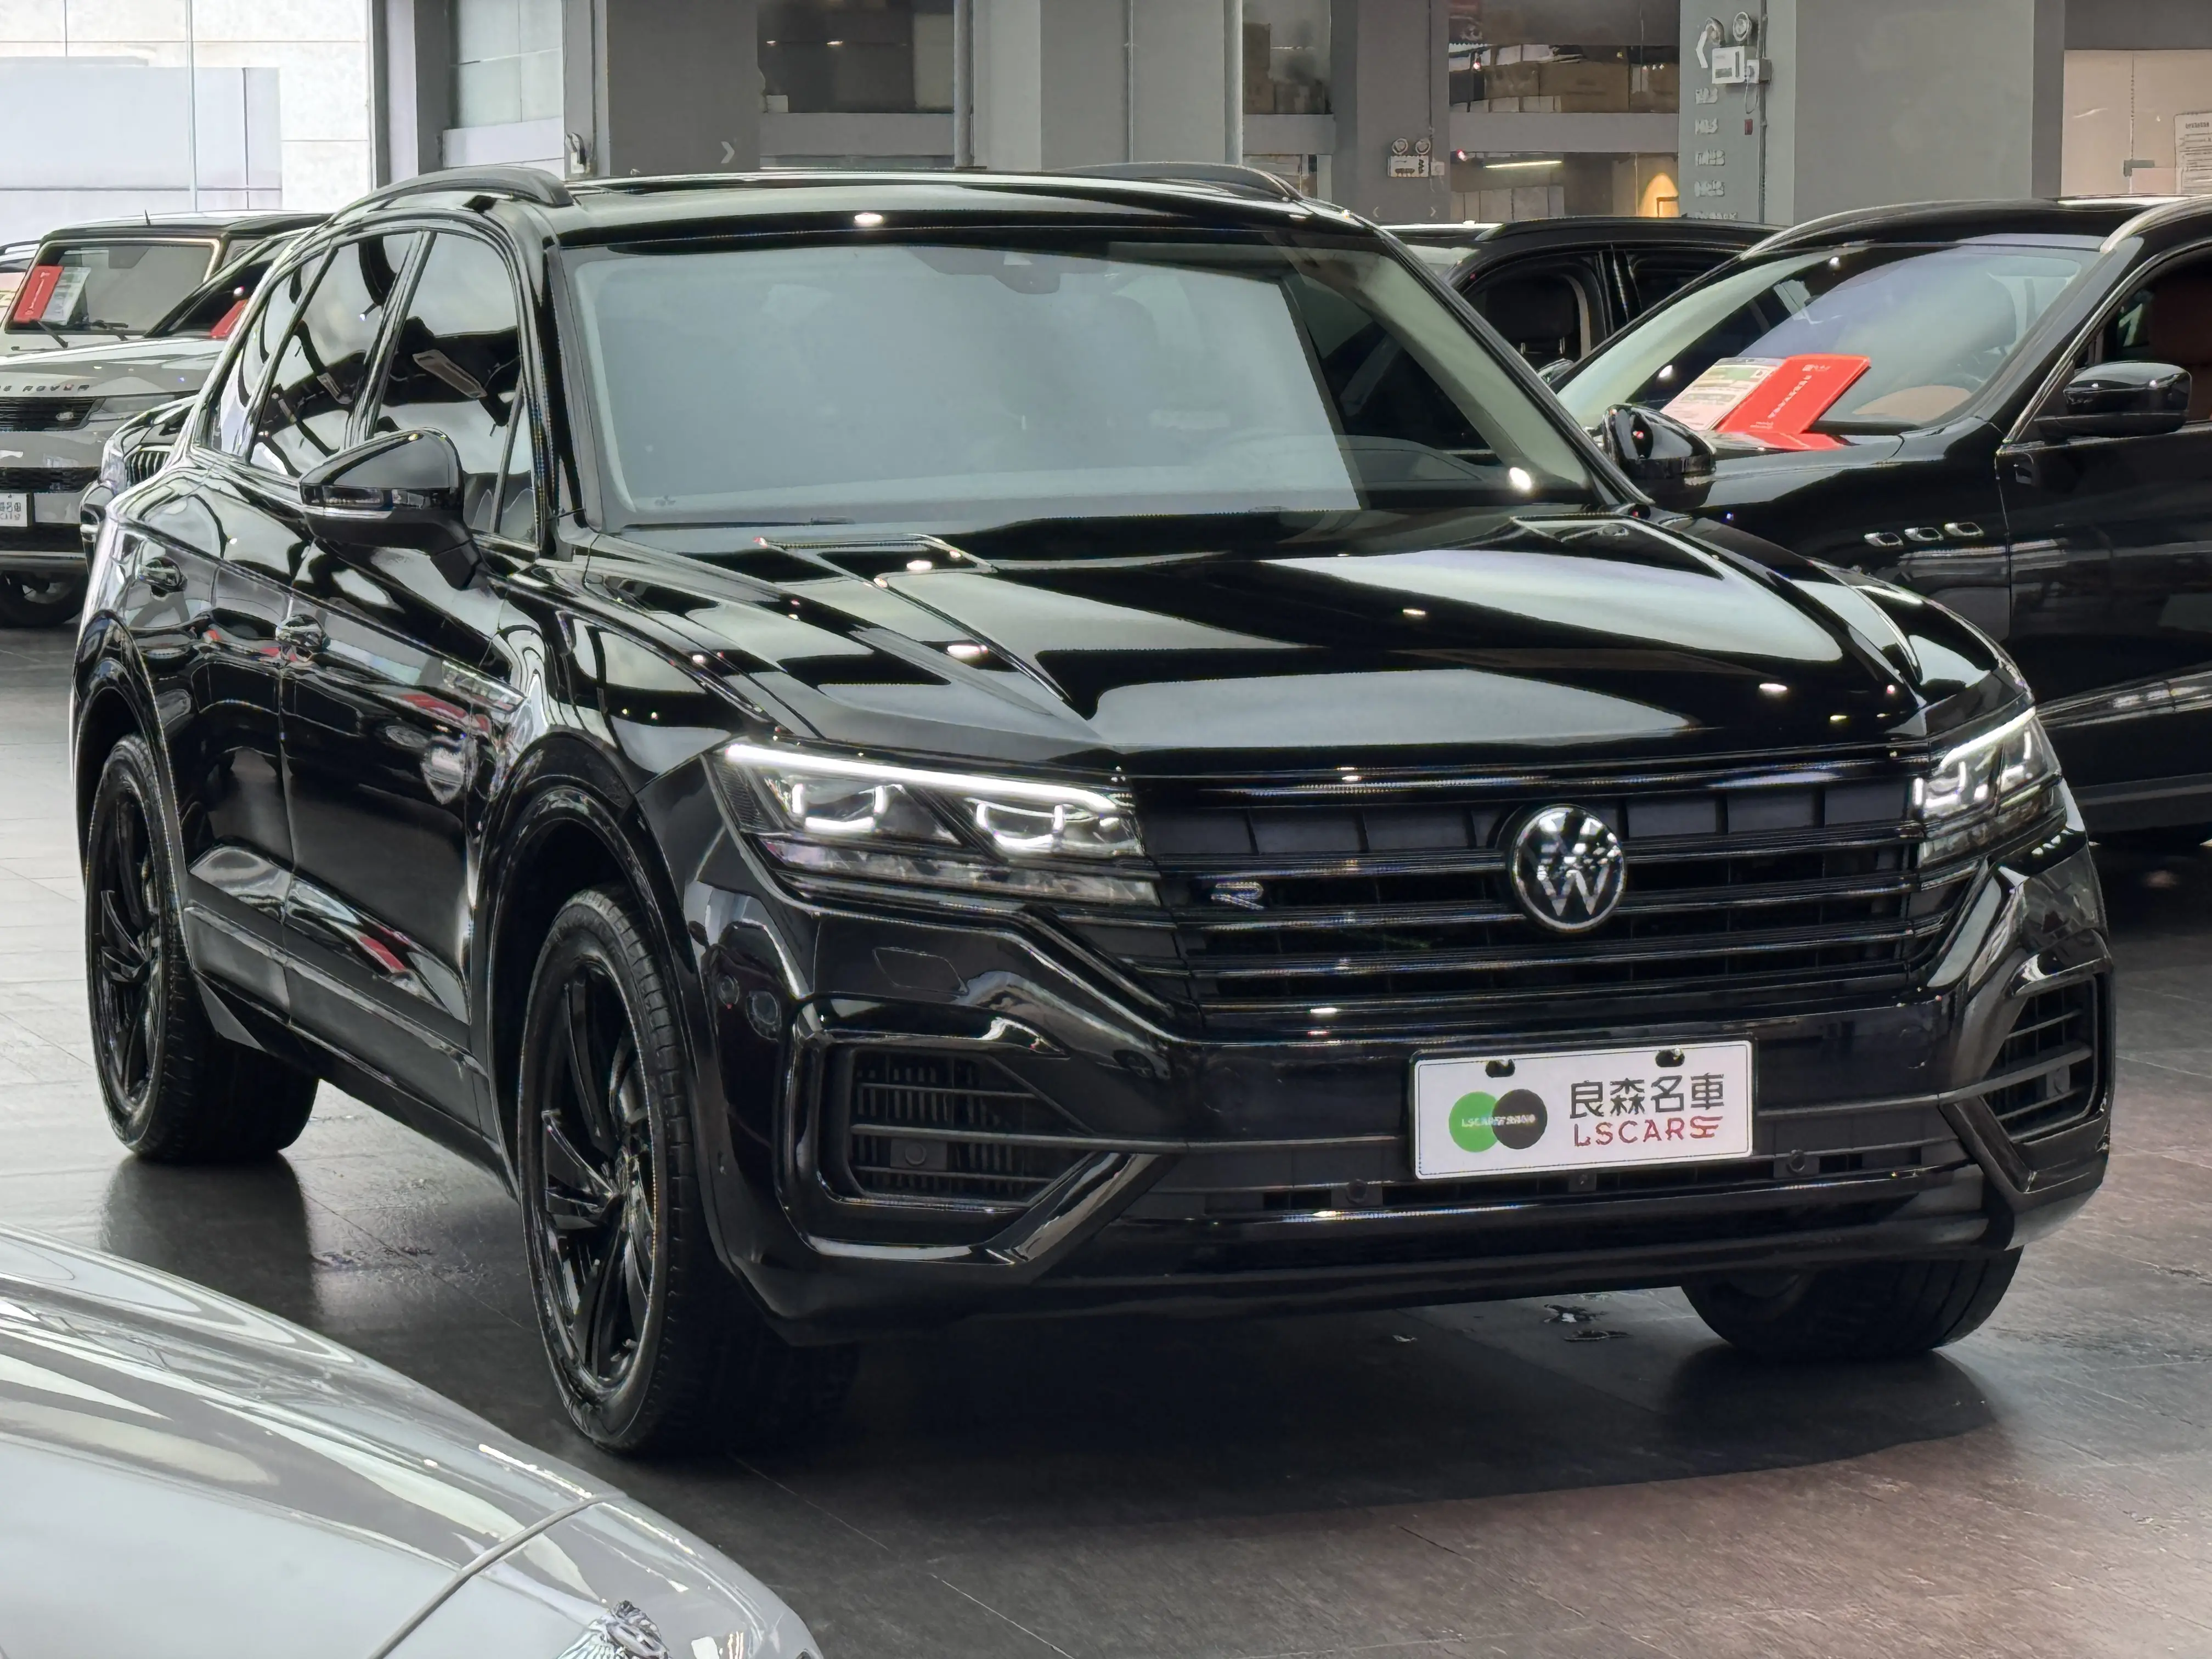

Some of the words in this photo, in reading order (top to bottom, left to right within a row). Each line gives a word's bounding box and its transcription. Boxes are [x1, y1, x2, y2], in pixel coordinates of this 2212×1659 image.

[1569, 1073, 1724, 1119] 良森名車
[1574, 1116, 1723, 1147] LSCARS
